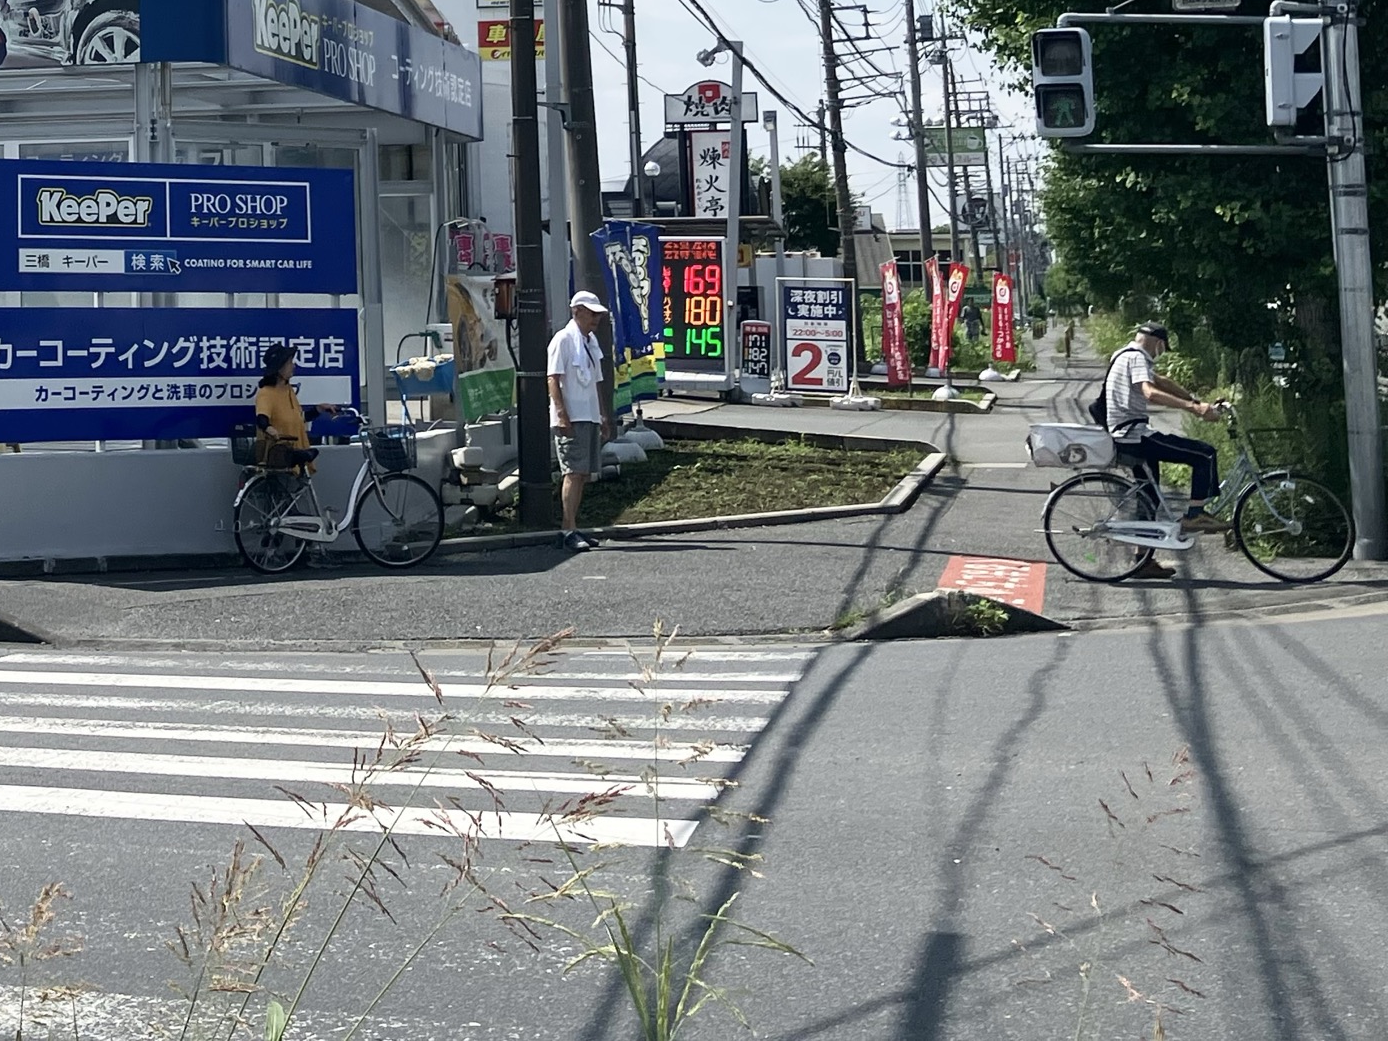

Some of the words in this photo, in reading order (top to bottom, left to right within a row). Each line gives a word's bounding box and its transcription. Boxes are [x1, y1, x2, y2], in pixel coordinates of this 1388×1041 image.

[324, 38, 347, 77] PRO
[348, 48, 375, 87] SHOP
[36, 187, 152, 227] KeePer
[191, 193, 231, 214] PRO
[236, 195, 288, 215] SHOP
[191, 216, 288, 229] キーパープロショップ
[25, 254, 50, 268] 三橋
[62, 255, 109, 268] キーパー
[131, 253, 165, 271] 検索
[184, 259, 225, 268] COATING
[226, 259, 244, 268] FOR
[246, 259, 275, 269] SMART
[277, 260, 294, 269] CAR
[296, 260, 312, 269] LIFE
[684, 265, 721, 294] 169
[790, 290, 843, 304] 深夜割引
[685, 296, 721, 326] 180
[797, 305, 837, 318] 実施中
[685, 327, 722, 357] 145
[749, 348, 767, 361] 182
[791, 342, 823, 386] 2
[35, 382, 301, 402] カーコーティングと洗車のプロシプ
